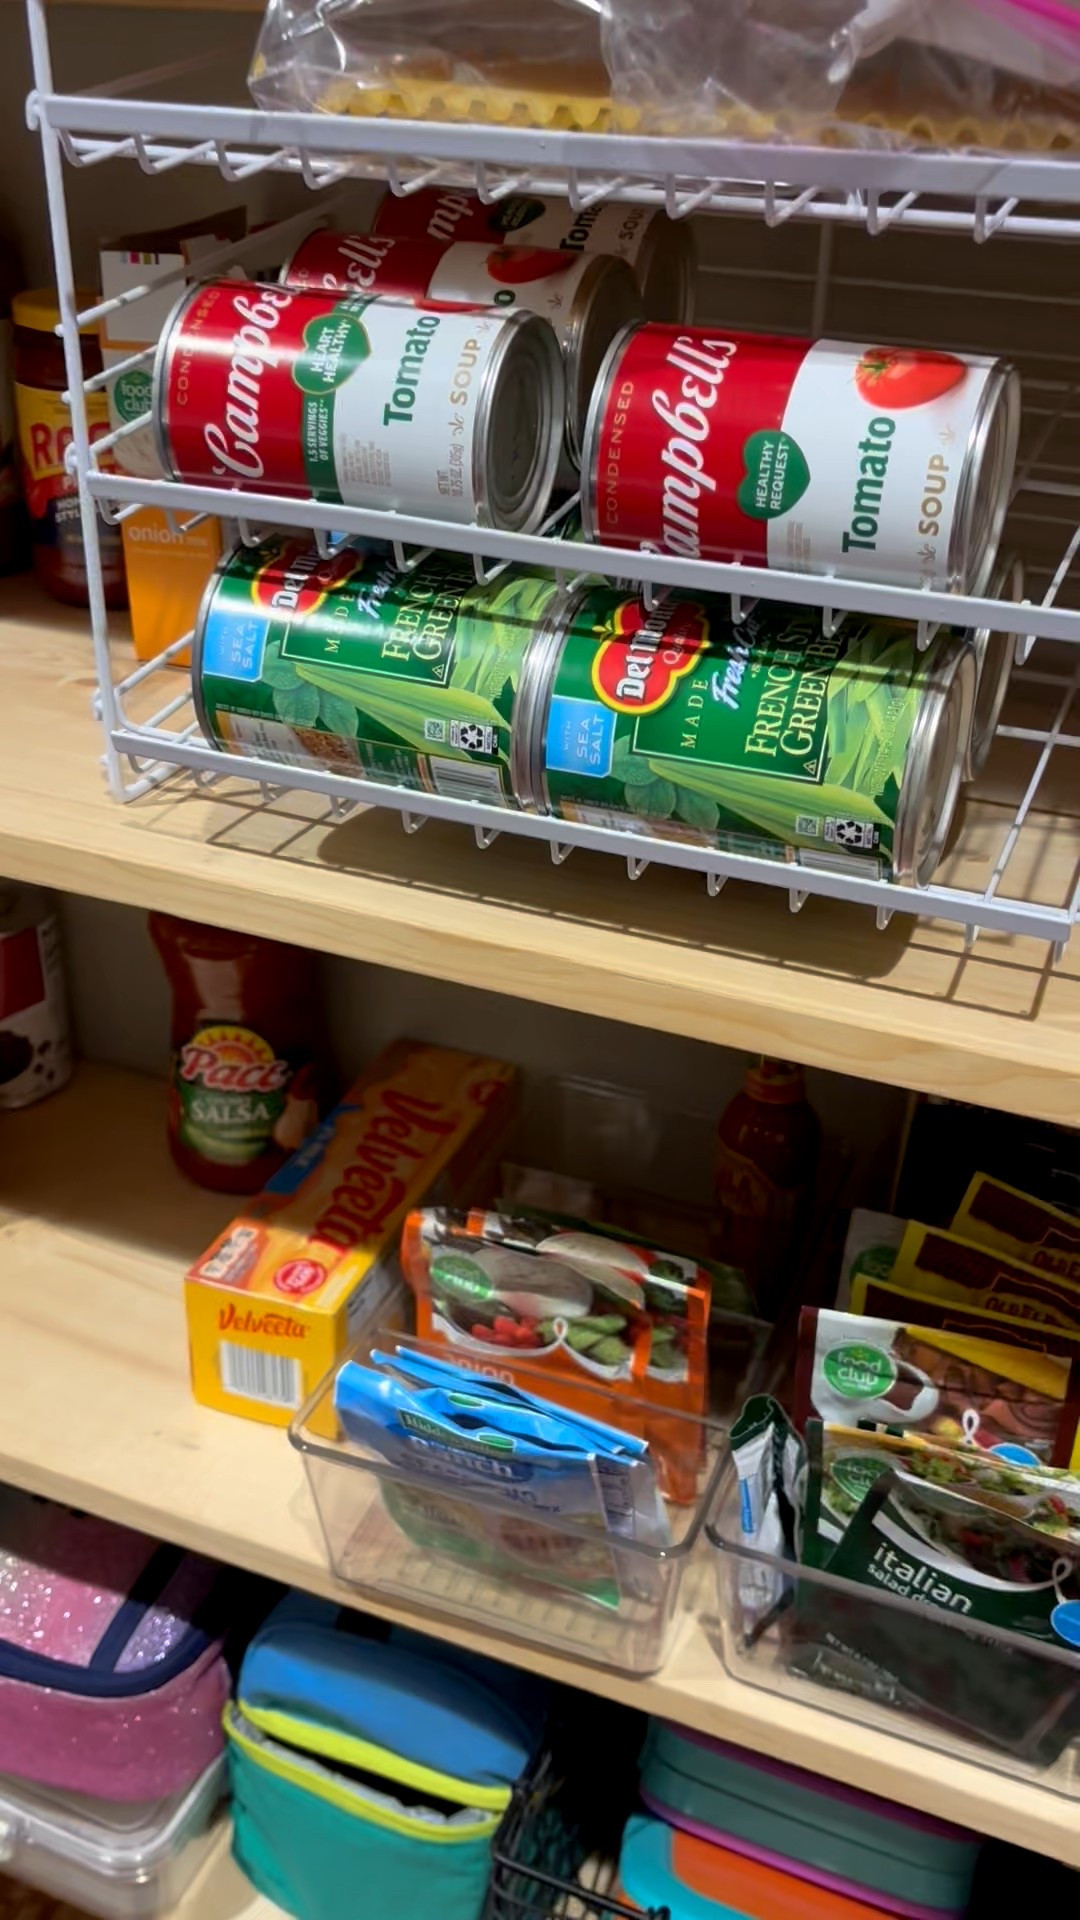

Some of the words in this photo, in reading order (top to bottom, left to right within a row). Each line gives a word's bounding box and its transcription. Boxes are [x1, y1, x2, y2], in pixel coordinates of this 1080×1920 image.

[560, 205, 603, 250] Toma
[619, 207, 646, 240] SOU
[176, 291, 221, 406] CONDNSED
[311, 327, 335, 373] HEART
[323, 319, 352, 383] HEALTHY
[383, 315, 441, 427] Tomato
[450, 338, 481, 406] SOUP
[306, 401, 318, 448] SERVINGS
[606, 380, 635, 525] CONDENSED
[646, 335, 738, 557] ampbell's
[755, 440, 775, 508] HEALTHY
[770, 442, 790, 510] REQUEST
[841, 416, 897, 553] Tomato
[917, 453, 949, 537] SOUP
[129, 524, 185, 544] onion
[231, 623, 246, 663] SEA
[241, 620, 259, 669] SALT
[324, 591, 356, 654] MDE
[412, 583, 468, 661] GREEN
[615, 653, 655, 700] Del
[711, 644, 752, 710] Fresh
[744, 647, 800, 758] FRENCH
[576, 717, 590, 759] SEA
[589, 714, 605, 766] SALT
[680, 678, 709, 750] MADE
[779, 662, 832, 756] GREEN
[190, 1100, 271, 1125] SALSA
[308, 1088, 459, 1256] Velveeta
[217, 1302, 310, 1339] Velveeta
[837, 1366, 879, 1386] club
[838, 1351, 883, 1373] food
[866, 1563, 912, 1597] salad
[873, 1541, 973, 1614] italian
